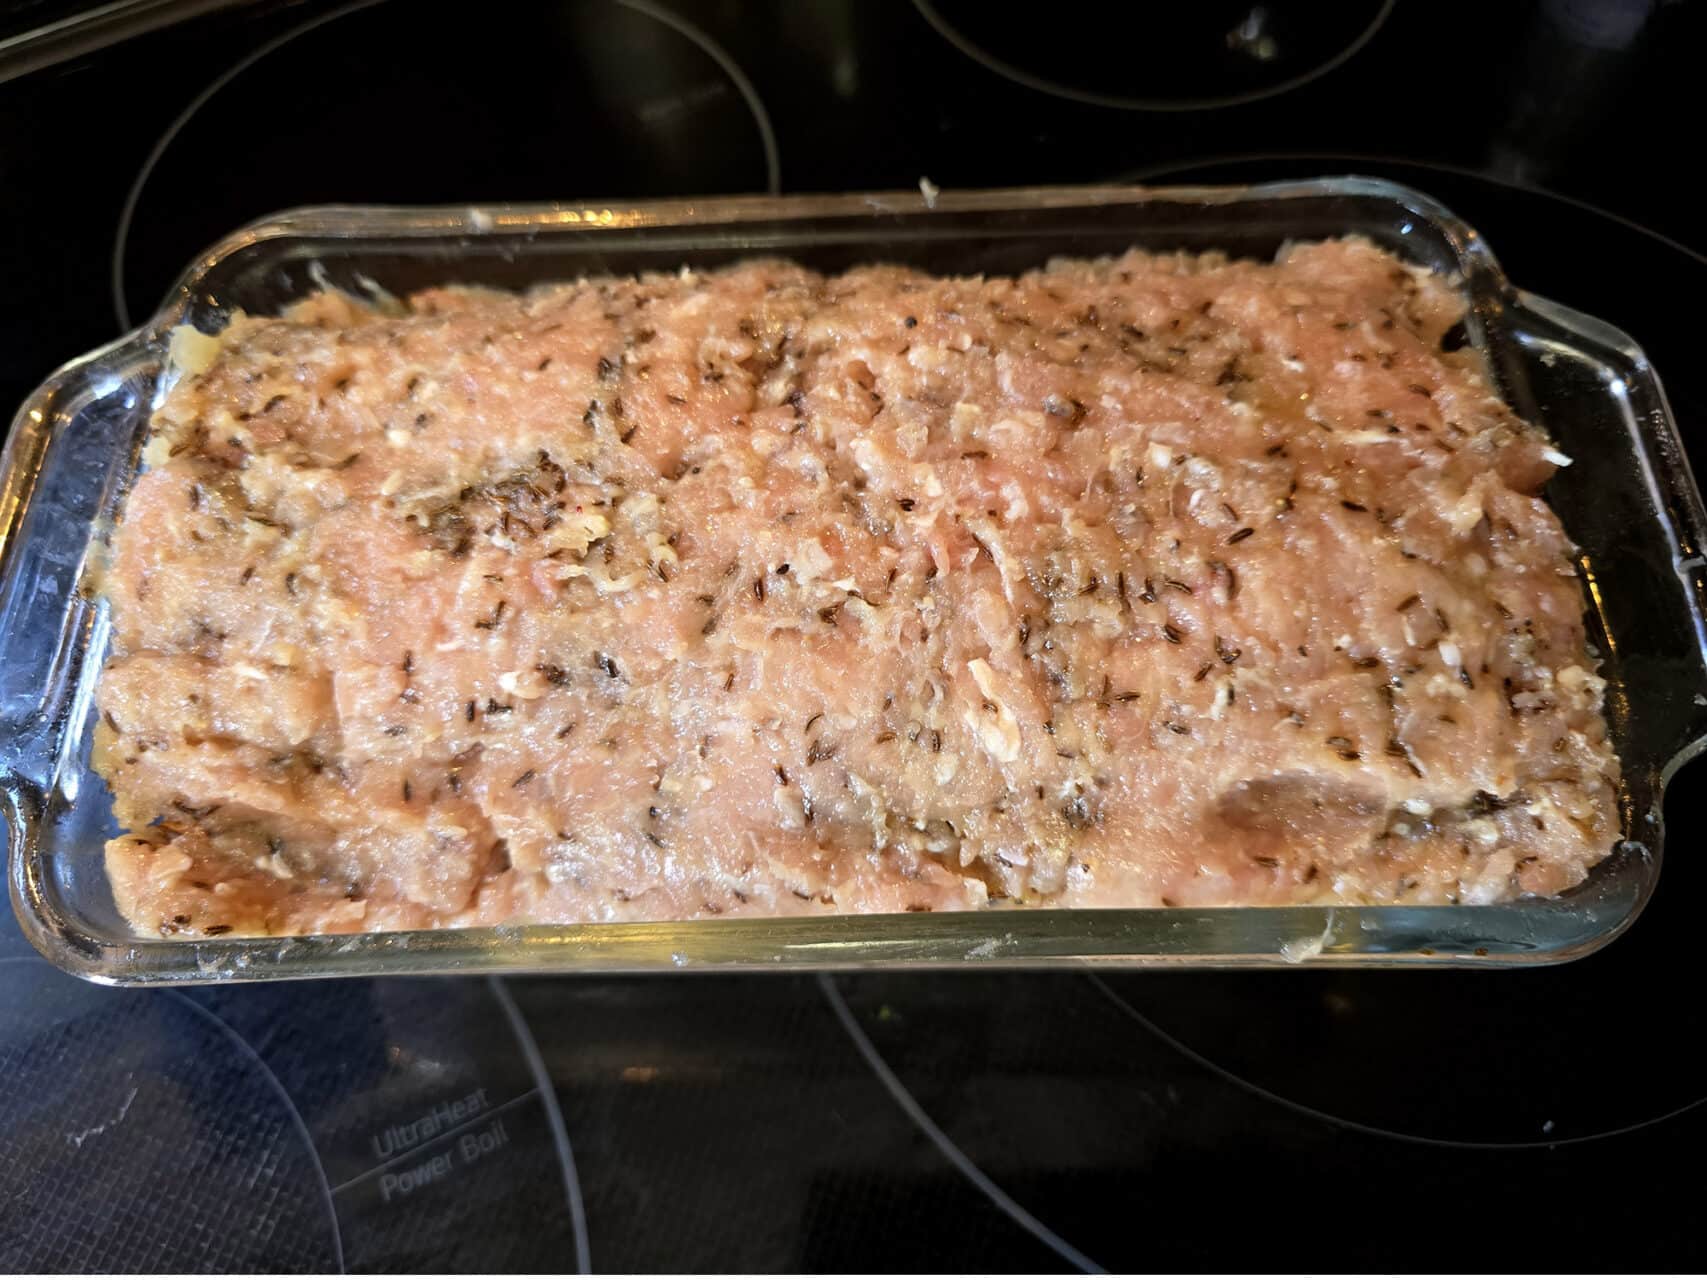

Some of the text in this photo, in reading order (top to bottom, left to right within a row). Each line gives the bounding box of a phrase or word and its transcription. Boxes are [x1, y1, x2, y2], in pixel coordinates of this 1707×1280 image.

[373, 1089, 489, 1158] UltraHeat
[380, 1119, 510, 1201] Power Boil
